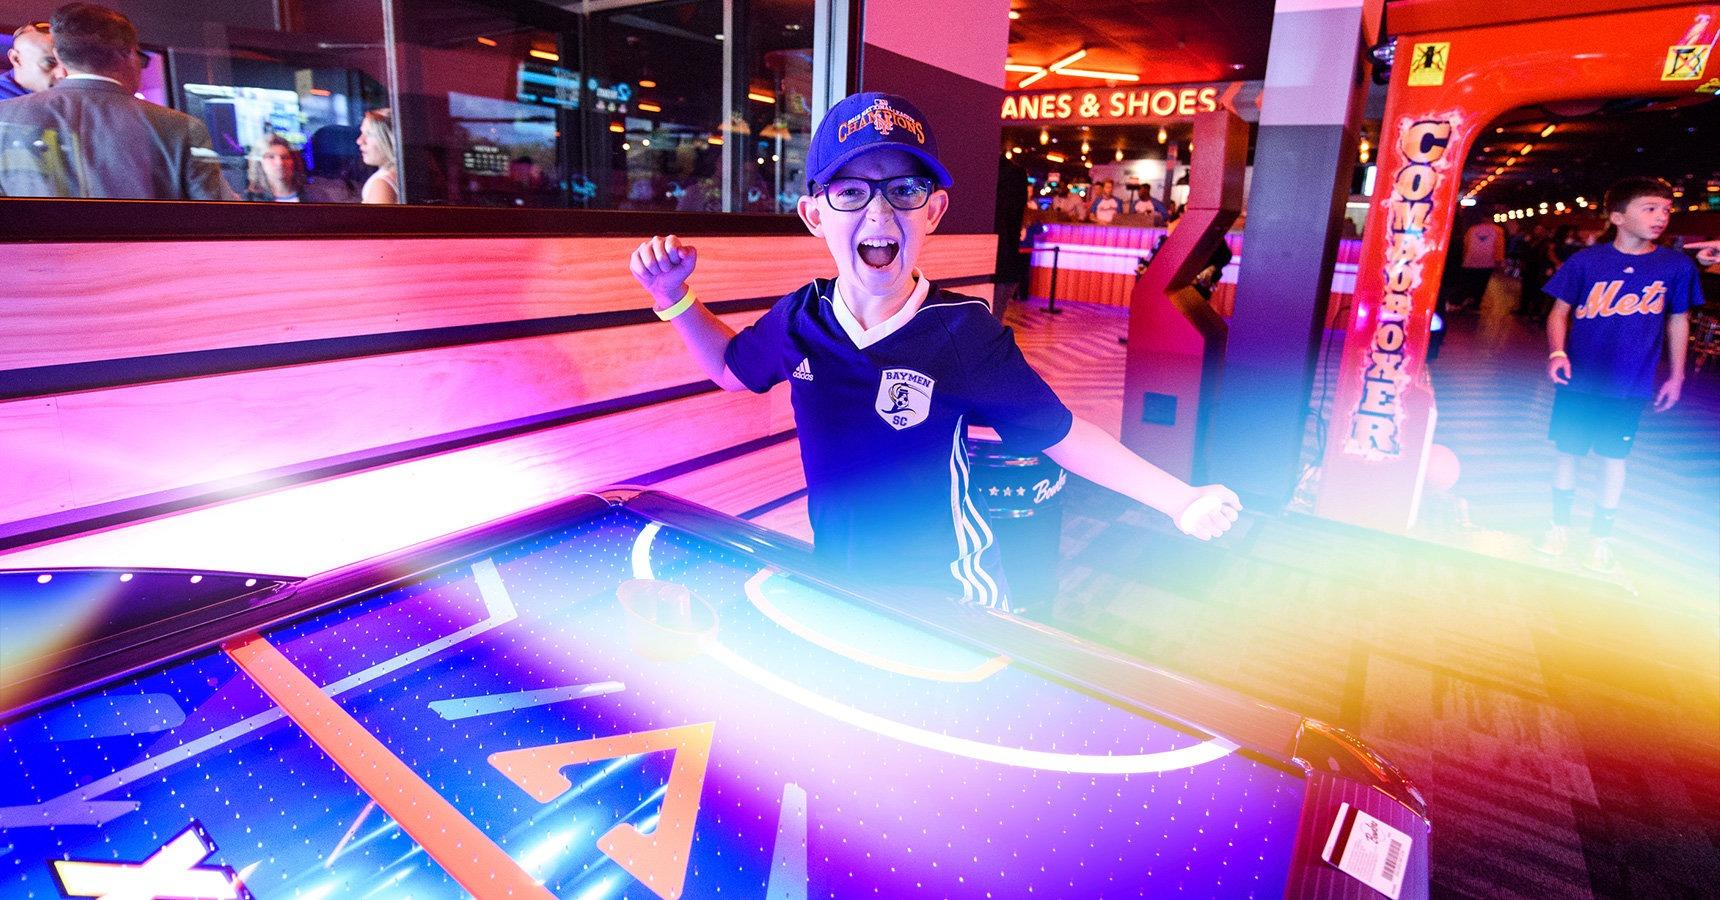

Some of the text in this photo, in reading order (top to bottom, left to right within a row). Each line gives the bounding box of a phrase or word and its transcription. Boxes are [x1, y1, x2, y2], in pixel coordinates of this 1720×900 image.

[1079, 93, 1099, 118] &
[1110, 88, 1217, 117] SHOES
[1575, 280, 1667, 319] Mets
[792, 370, 814, 382] adidas
[886, 371, 931, 388] BAYMEN
[892, 415, 908, 427] SC
